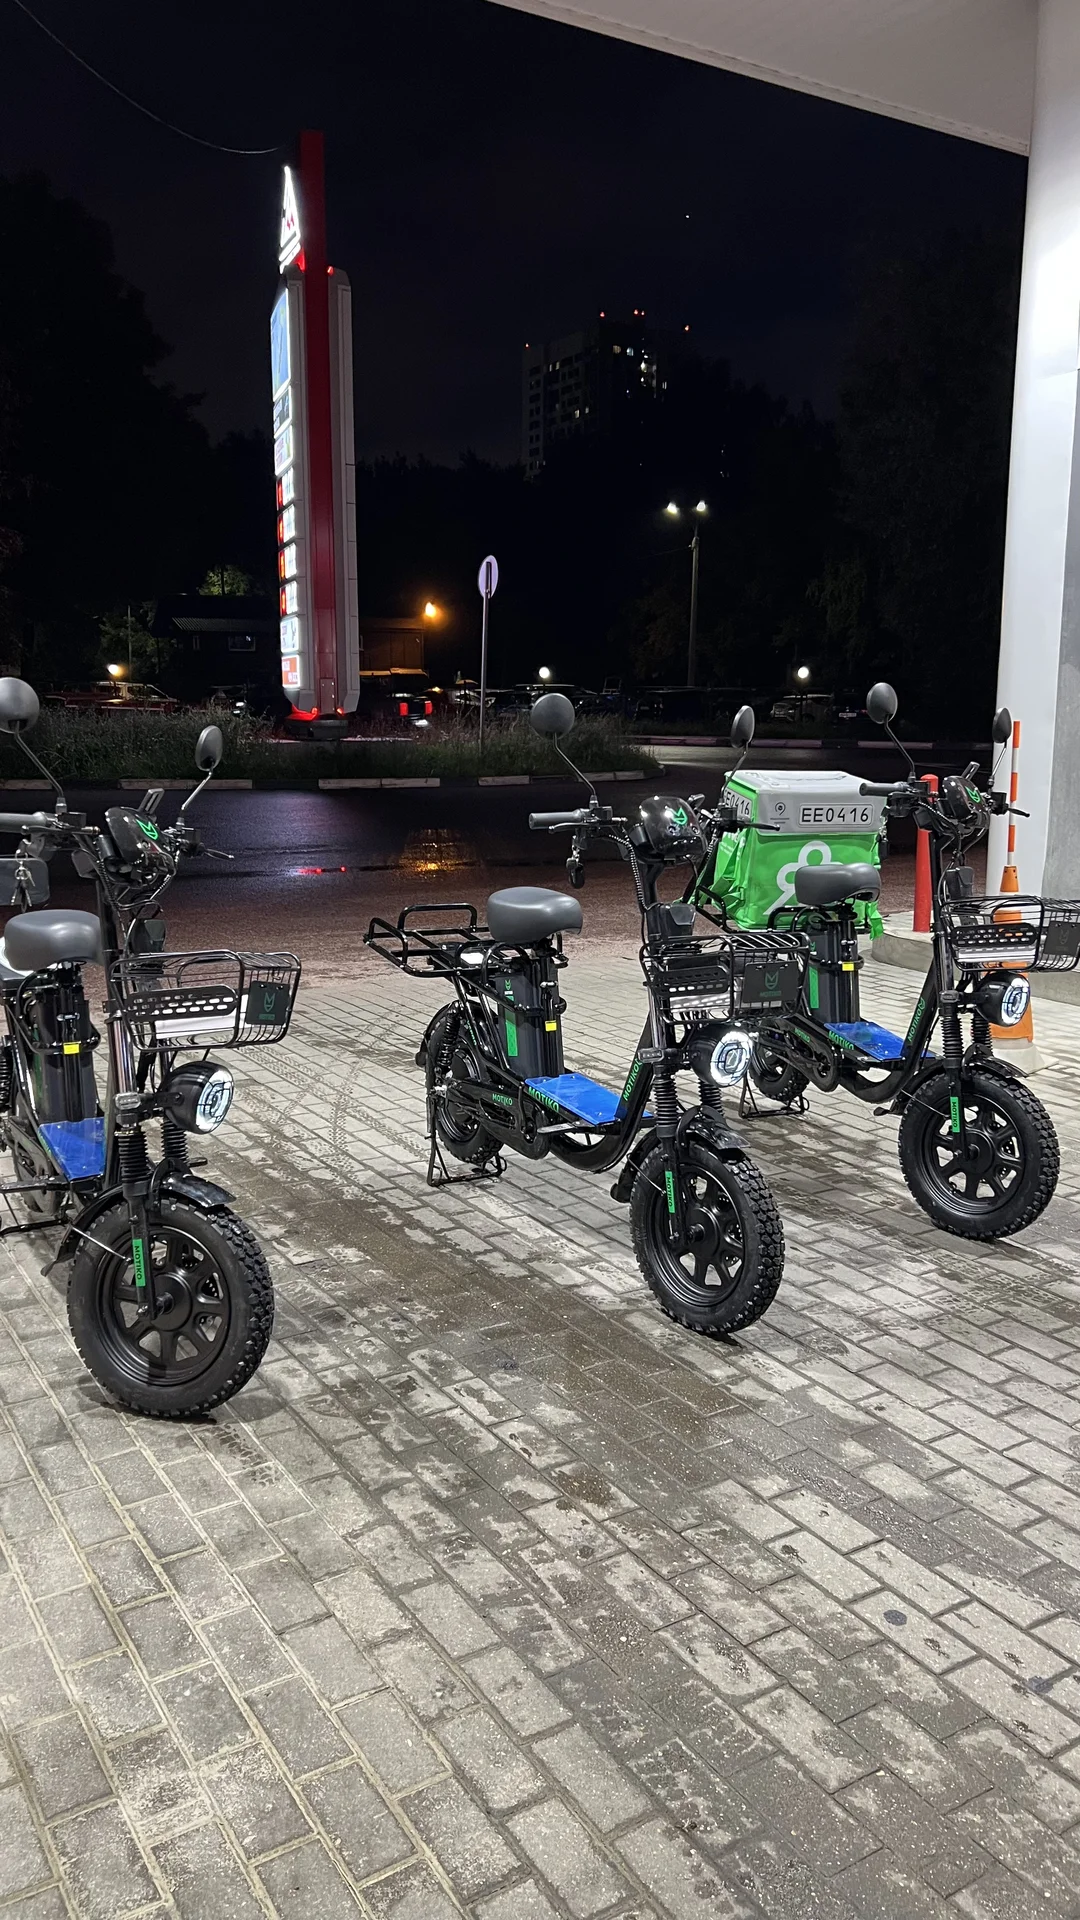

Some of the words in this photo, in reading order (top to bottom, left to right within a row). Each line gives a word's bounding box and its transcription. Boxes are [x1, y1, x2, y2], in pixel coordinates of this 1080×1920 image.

[801, 807, 869, 823] EE0416
[907, 1008, 922, 1042] MOTIKO
[828, 1030, 854, 1051] MOTIKO
[622, 1063, 639, 1101] MOTIKO
[491, 1093, 513, 1106] MOTIKO
[527, 1086, 559, 1113] MOTIKO
[134, 1245, 142, 1280] MOTIKO
